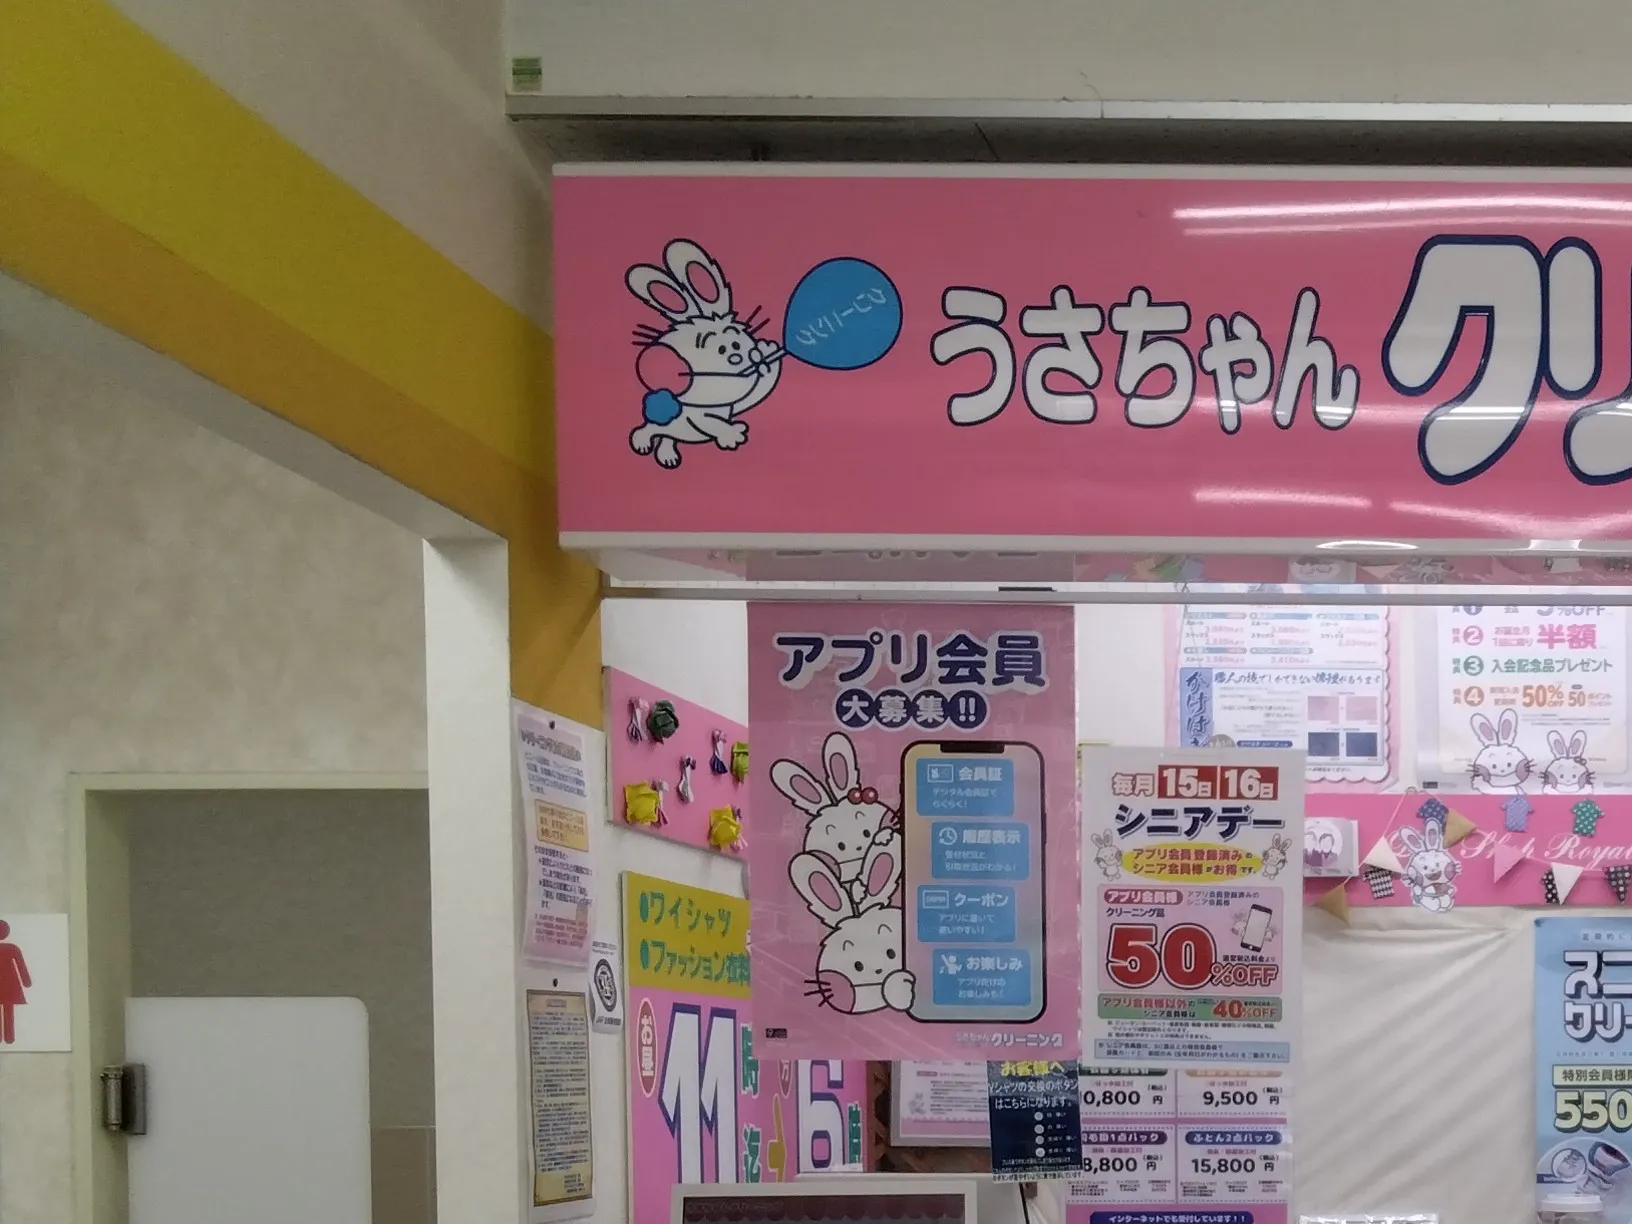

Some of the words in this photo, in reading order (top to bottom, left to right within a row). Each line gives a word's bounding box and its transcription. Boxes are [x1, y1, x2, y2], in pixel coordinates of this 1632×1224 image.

[930, 285, 1361, 434] うさちゃん
[1537, 624, 1597, 650] 半額
[776, 631, 1046, 687] アプリ会員
[1491, 658, 1613, 674] 入会記念品プレゼント
[839, 691, 984, 725] 大募集!!
[958, 766, 1003, 782] 会員証
[1112, 772, 1155, 796] 毎月
[1162, 767, 1212, 798] 15日
[1224, 768, 1274, 799] 16日
[1115, 804, 1286, 841] シニアデー
[954, 892, 1009, 908] クーポン
[1107, 890, 1179, 905] アプリ会員様
[651, 892, 731, 937] ワイシャツ
[1105, 908, 1165, 918] クリーニング品
[965, 956, 1023, 973] お楽しみ
[1105, 922, 1217, 990] 50
[1211, 963, 1279, 987] %OFF
[1212, 999, 1244, 1018] 40
[991, 1032, 1063, 1048] クリーニング
[1000, 1060, 1065, 1077] お客様へ
[1080, 1090, 1141, 1107] 0,800
[1152, 1095, 1163, 1105] 円
[1202, 1091, 1258, 1107] 9,500
[1269, 1096, 1280, 1105] 円
[1146, 1162, 1157, 1171] 円
[1191, 1158, 1256, 1175] 15,800
[1264, 1162, 1275, 1172] 円
